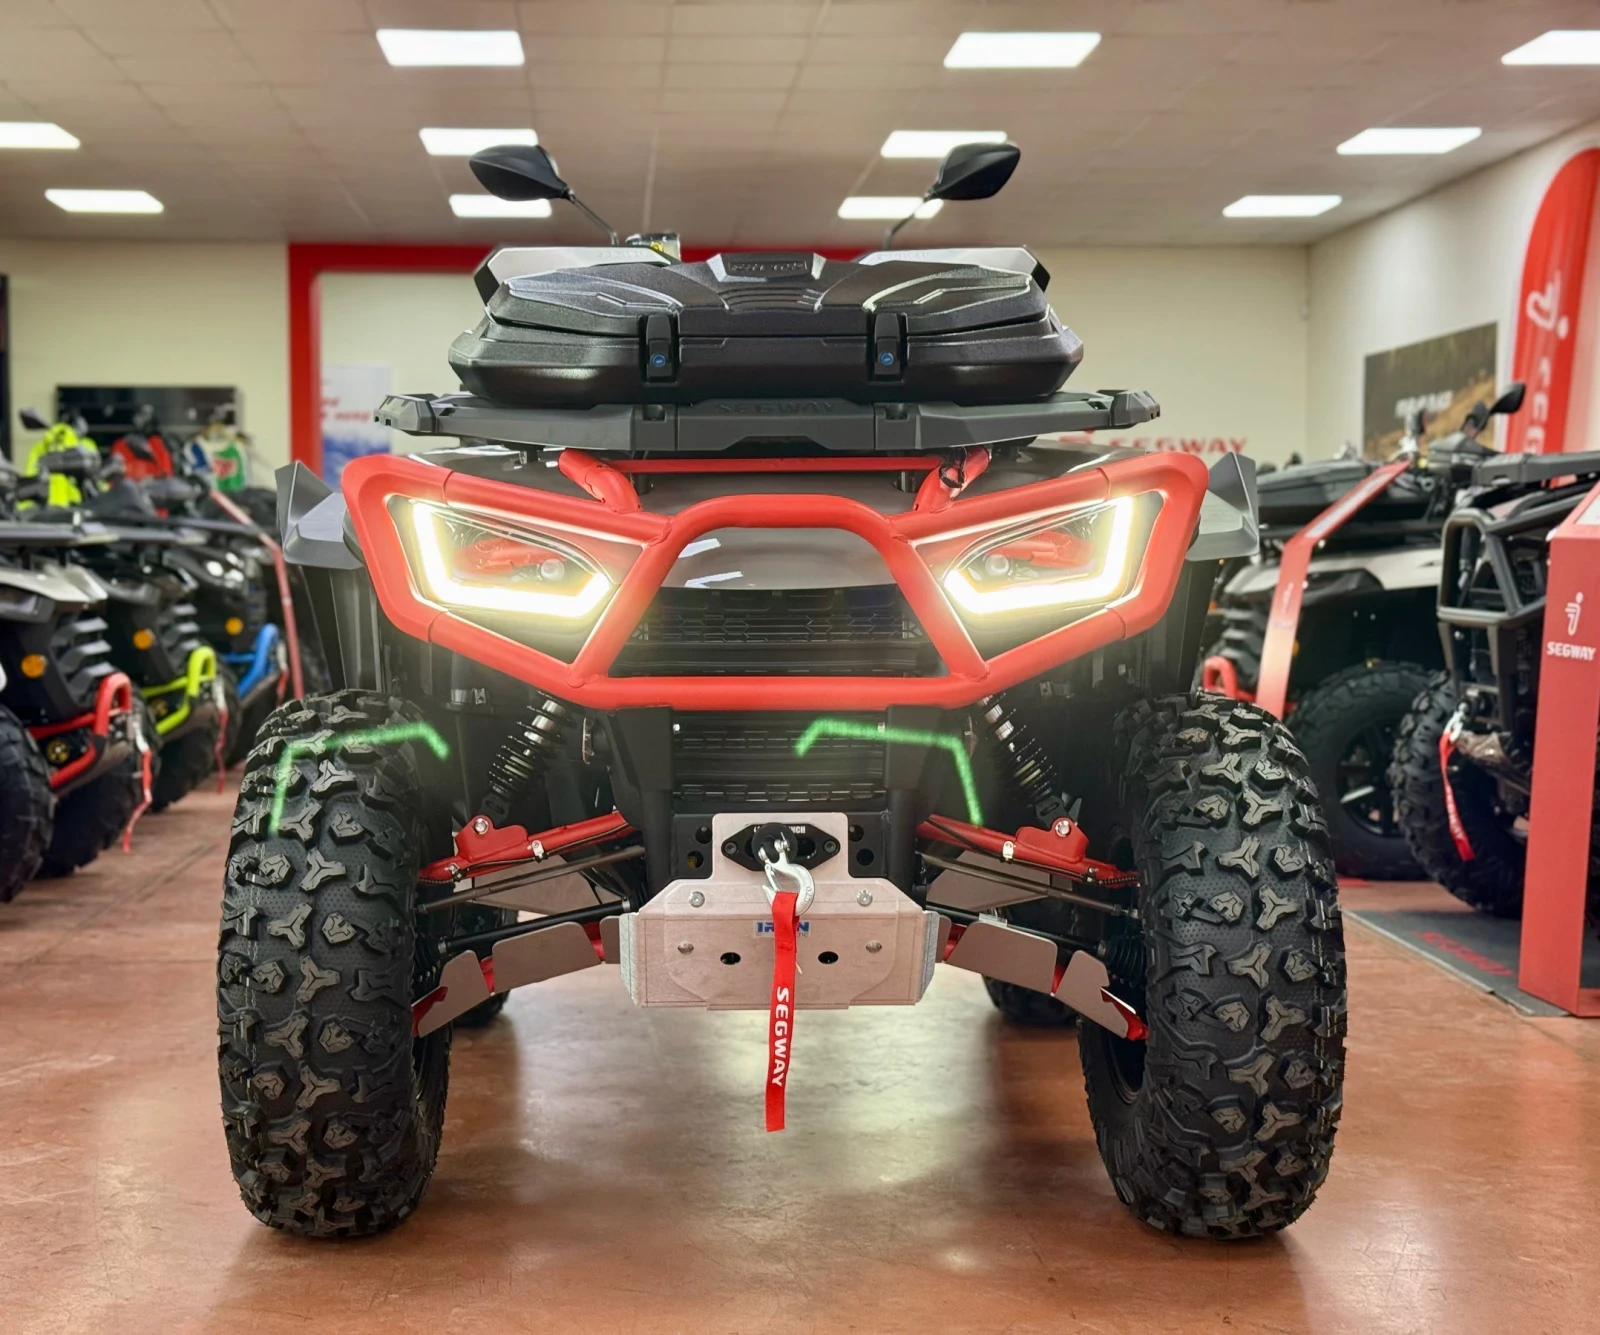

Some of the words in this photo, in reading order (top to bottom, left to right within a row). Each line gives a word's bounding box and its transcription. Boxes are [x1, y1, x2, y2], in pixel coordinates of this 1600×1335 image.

[1547, 641, 1596, 661] SEGWAY
[757, 921, 809, 933] IRN
[772, 986, 789, 1087] SEGWAY
